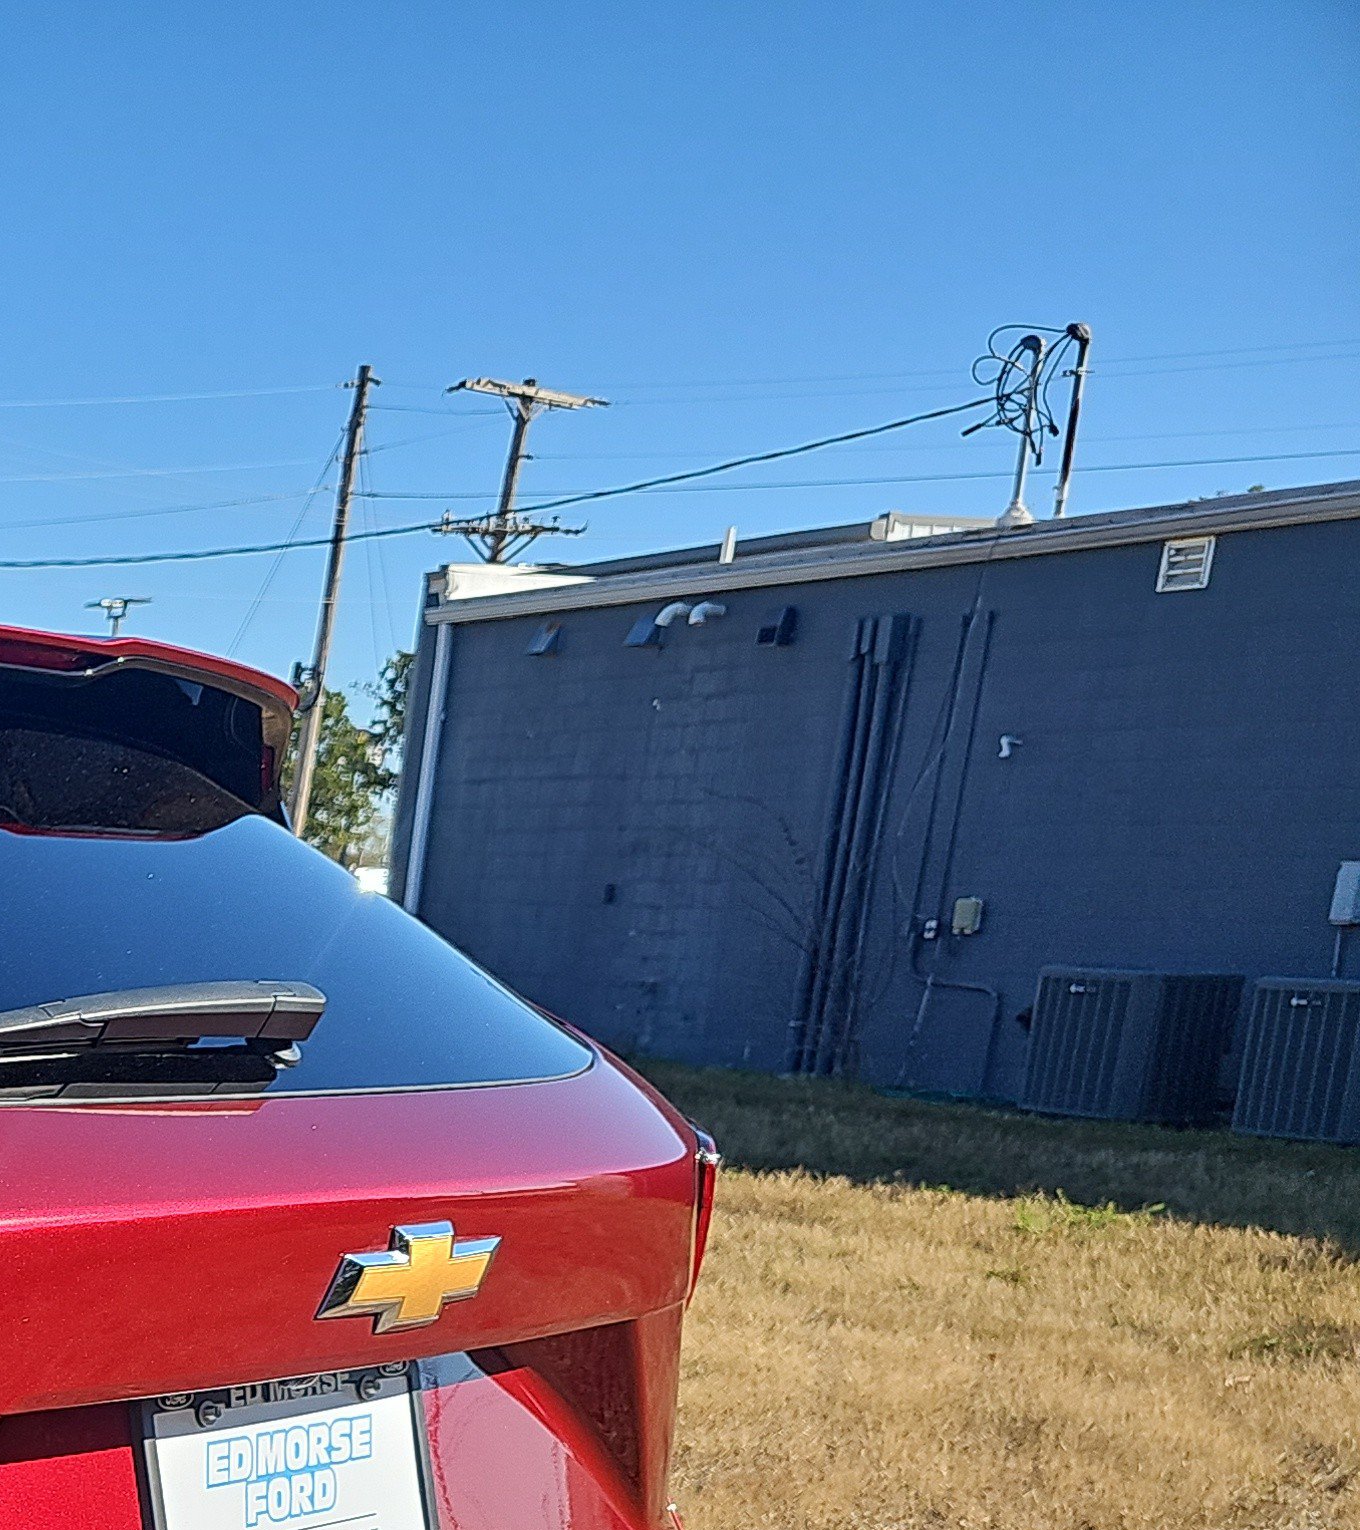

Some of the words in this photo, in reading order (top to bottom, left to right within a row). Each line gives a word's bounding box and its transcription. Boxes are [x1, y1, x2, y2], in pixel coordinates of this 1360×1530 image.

[206, 1434, 254, 1489] ED
[254, 1414, 372, 1478] MORSE
[245, 1467, 338, 1528] FORD
